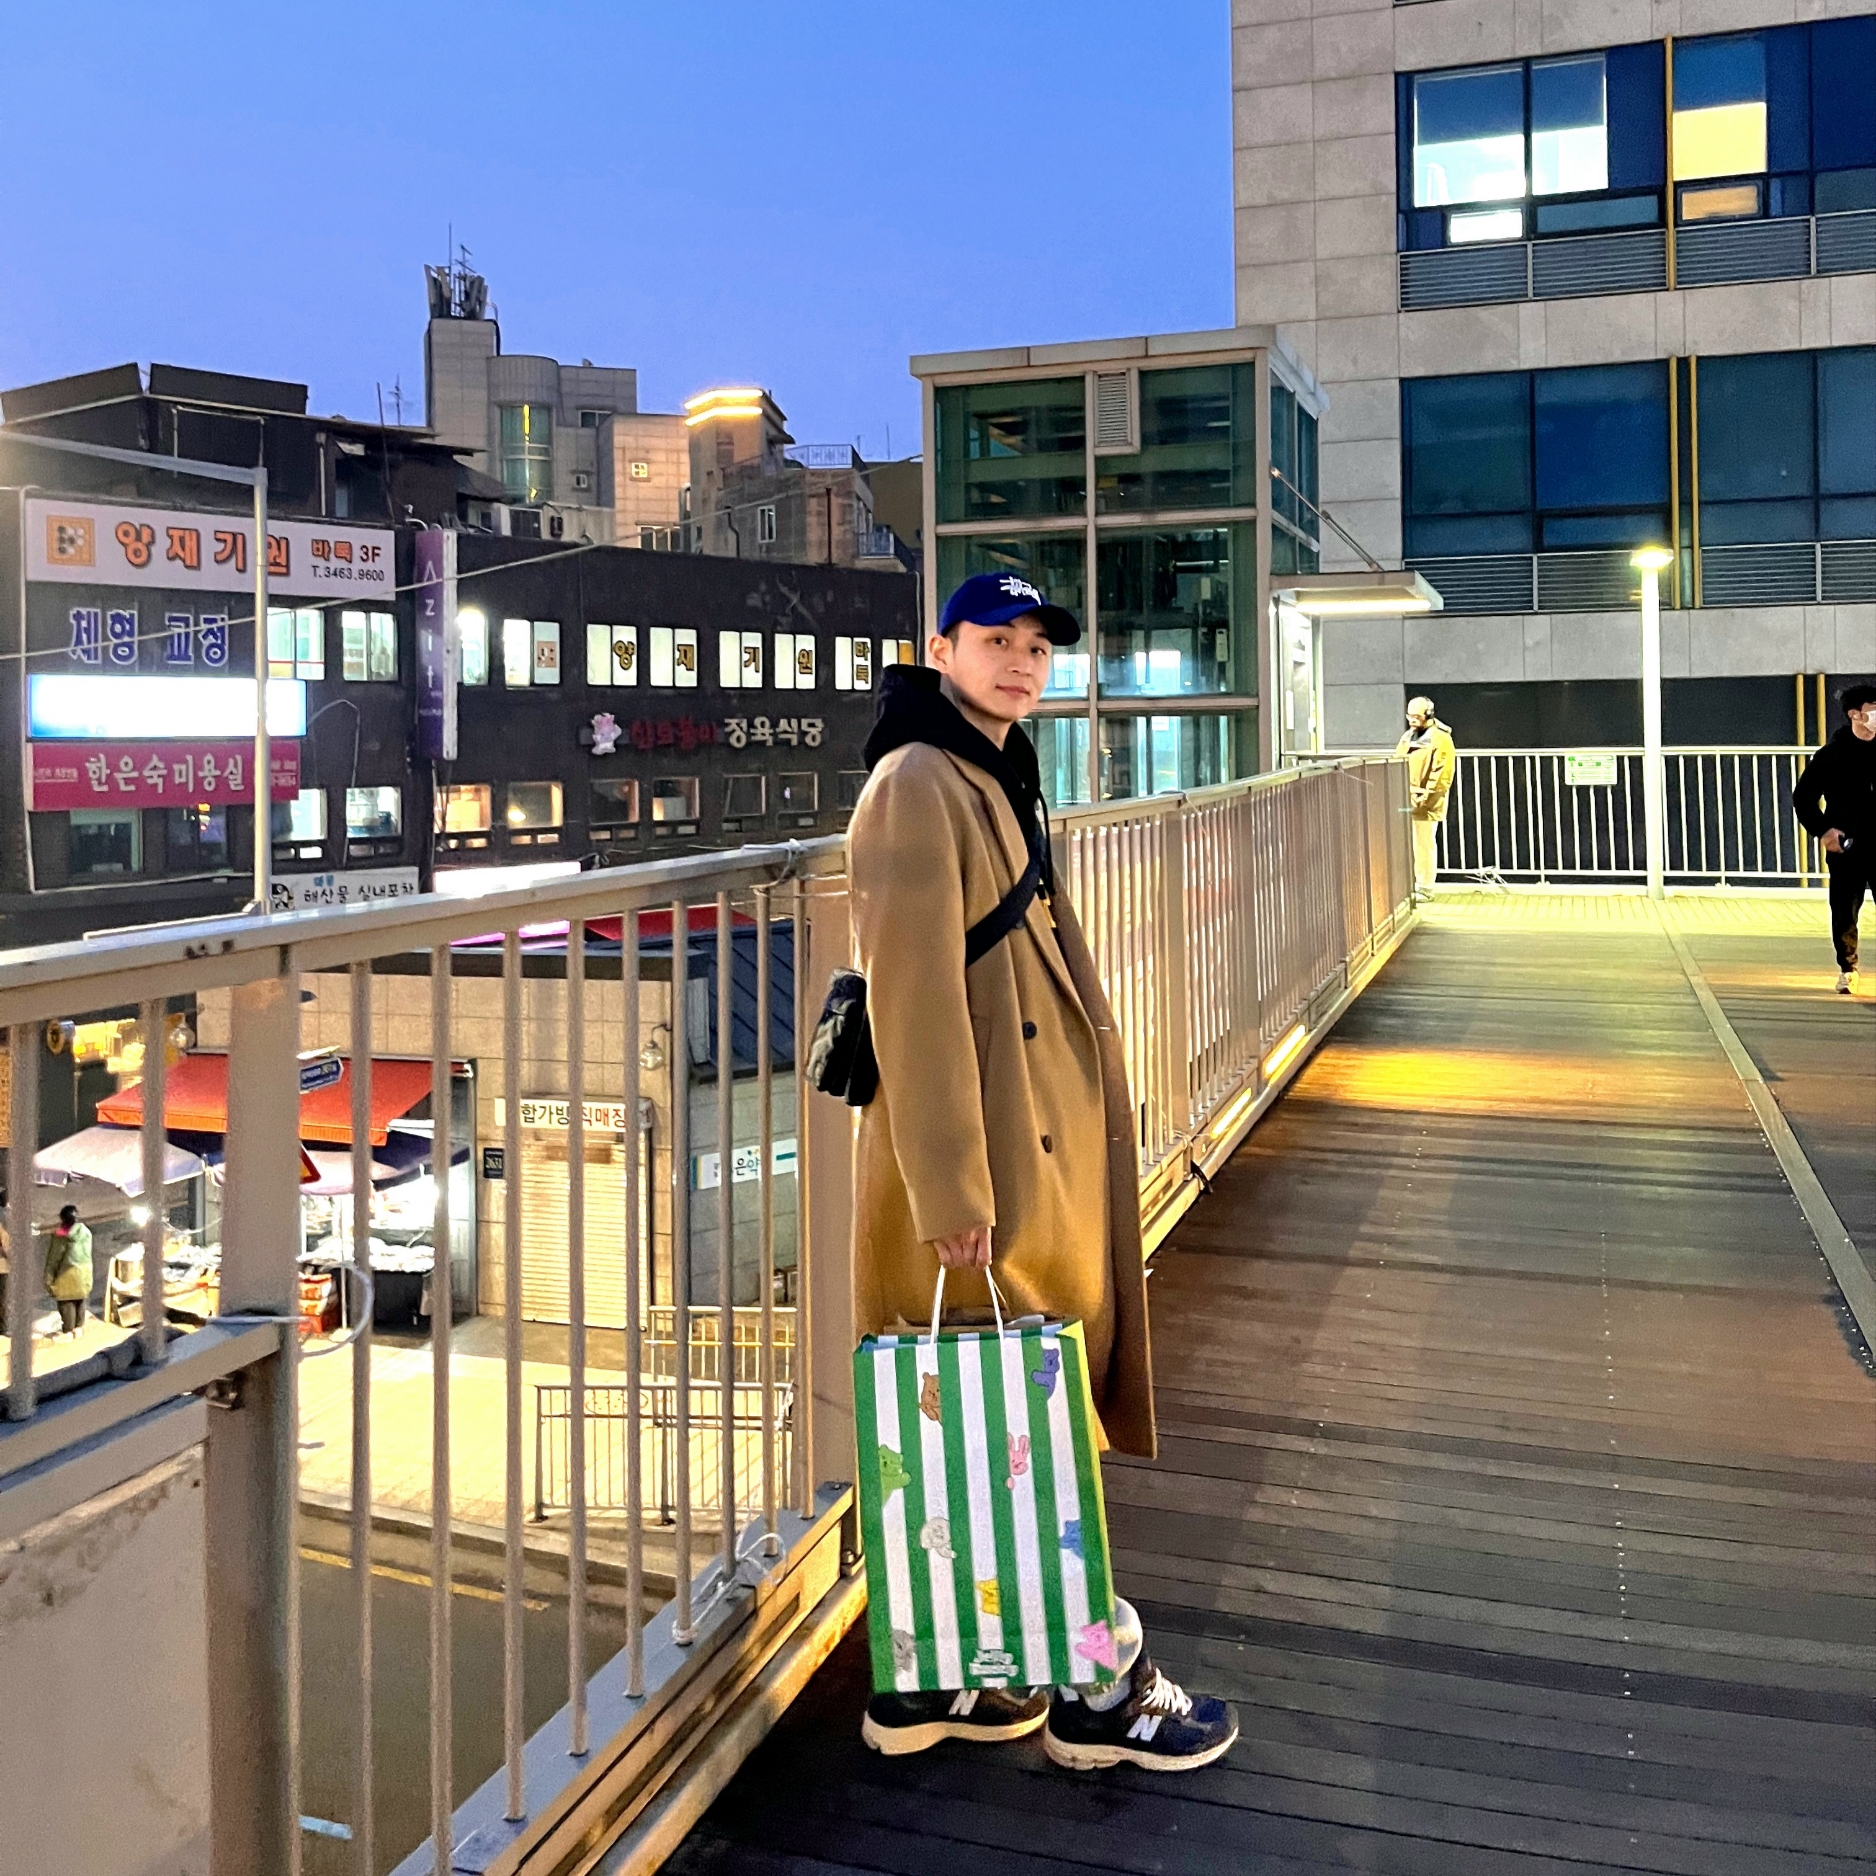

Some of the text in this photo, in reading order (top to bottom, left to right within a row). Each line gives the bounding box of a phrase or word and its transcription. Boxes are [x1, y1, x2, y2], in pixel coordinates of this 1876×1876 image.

[115, 521, 289, 577] 양재기원
[360, 545, 382, 563] 3F
[311, 565, 385, 582] T.3463.9600
[69, 607, 229, 667] 체형 교정
[614, 640, 814, 675] 양재기원
[855, 641, 870, 684] 바둑
[724, 716, 824, 749] 정육식당
[85, 753, 245, 794] 한은숙미용실
[304, 885, 349, 904] 해산물
[521, 1104, 570, 1126] 합가방
[1127, 1714, 1163, 1742] N
